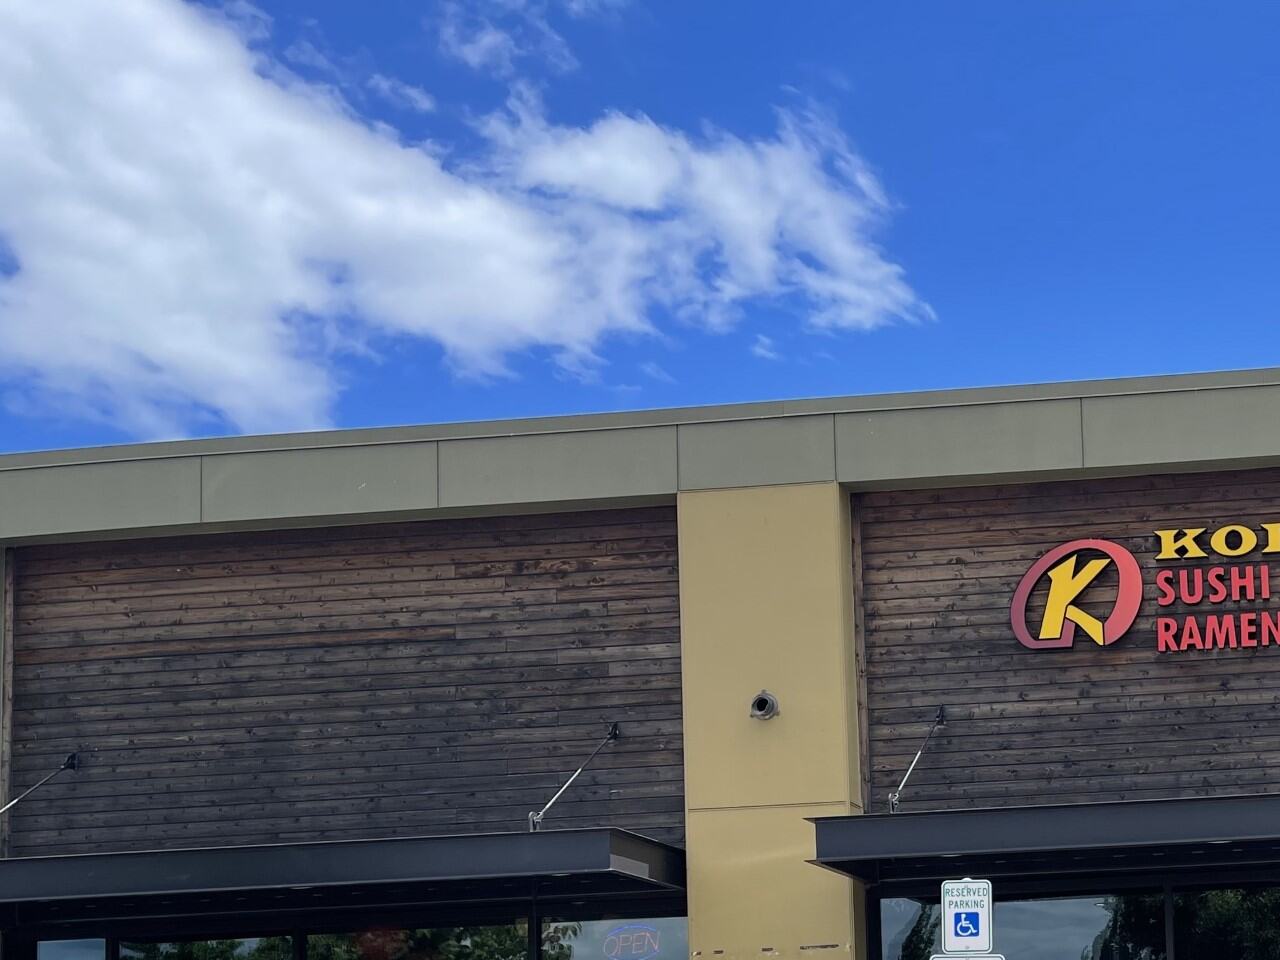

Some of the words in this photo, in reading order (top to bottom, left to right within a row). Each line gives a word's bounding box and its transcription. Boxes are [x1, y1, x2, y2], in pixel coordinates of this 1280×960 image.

[1156, 564, 1271, 606] SUSHI
[945, 887, 988, 897] RESERVED
[948, 899, 985, 909] PARKING
[603, 931, 661, 956] OPEN
